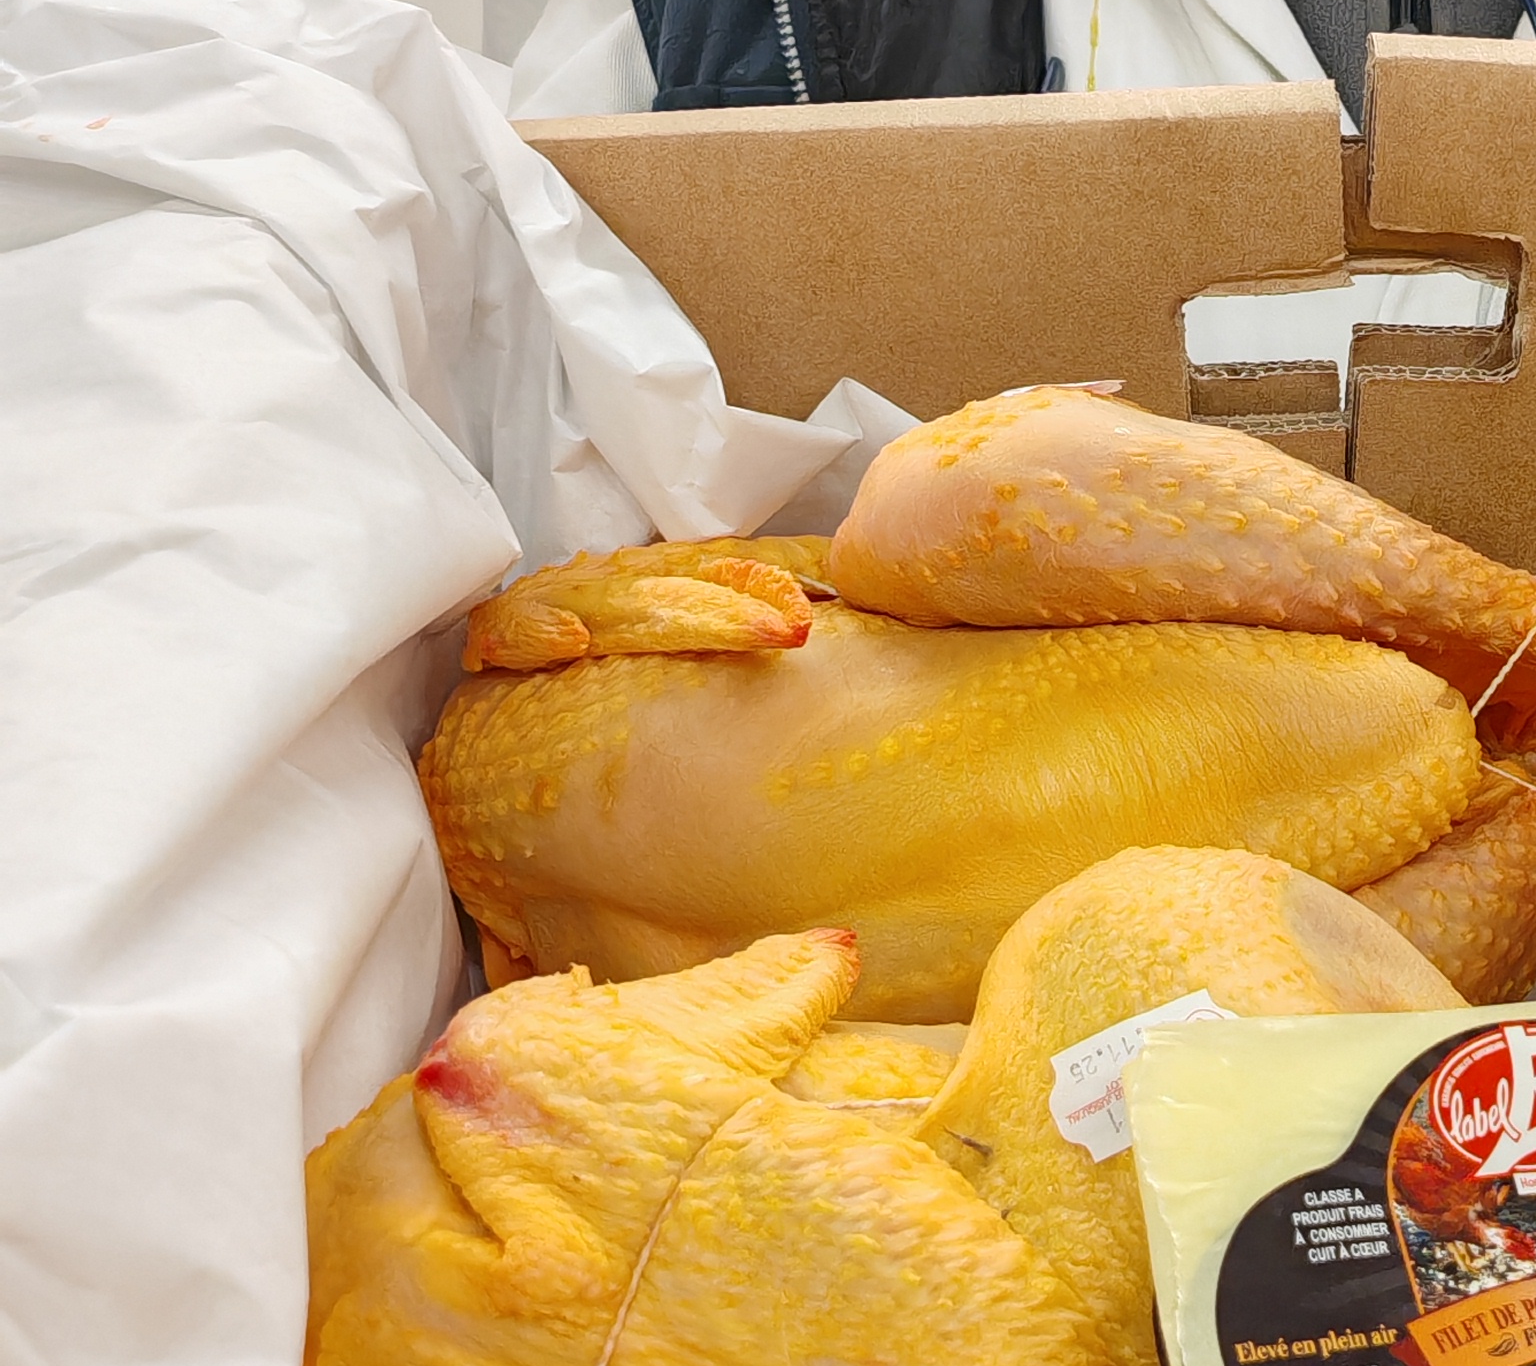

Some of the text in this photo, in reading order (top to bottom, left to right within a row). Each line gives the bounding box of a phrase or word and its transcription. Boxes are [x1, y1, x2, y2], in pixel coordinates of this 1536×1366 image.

[1304, 1188, 1365, 1206] CLASSE A
[1292, 1204, 1385, 1226] PRODUIT FRAIS
[1295, 1222, 1390, 1245] À CONSOMMER
[1308, 1240, 1390, 1263] CUIT À CŒUR
[1431, 1307, 1491, 1353] FILET
[1490, 1301, 1523, 1329] DE
[1235, 1324, 1399, 1365] Elevé en plein air
